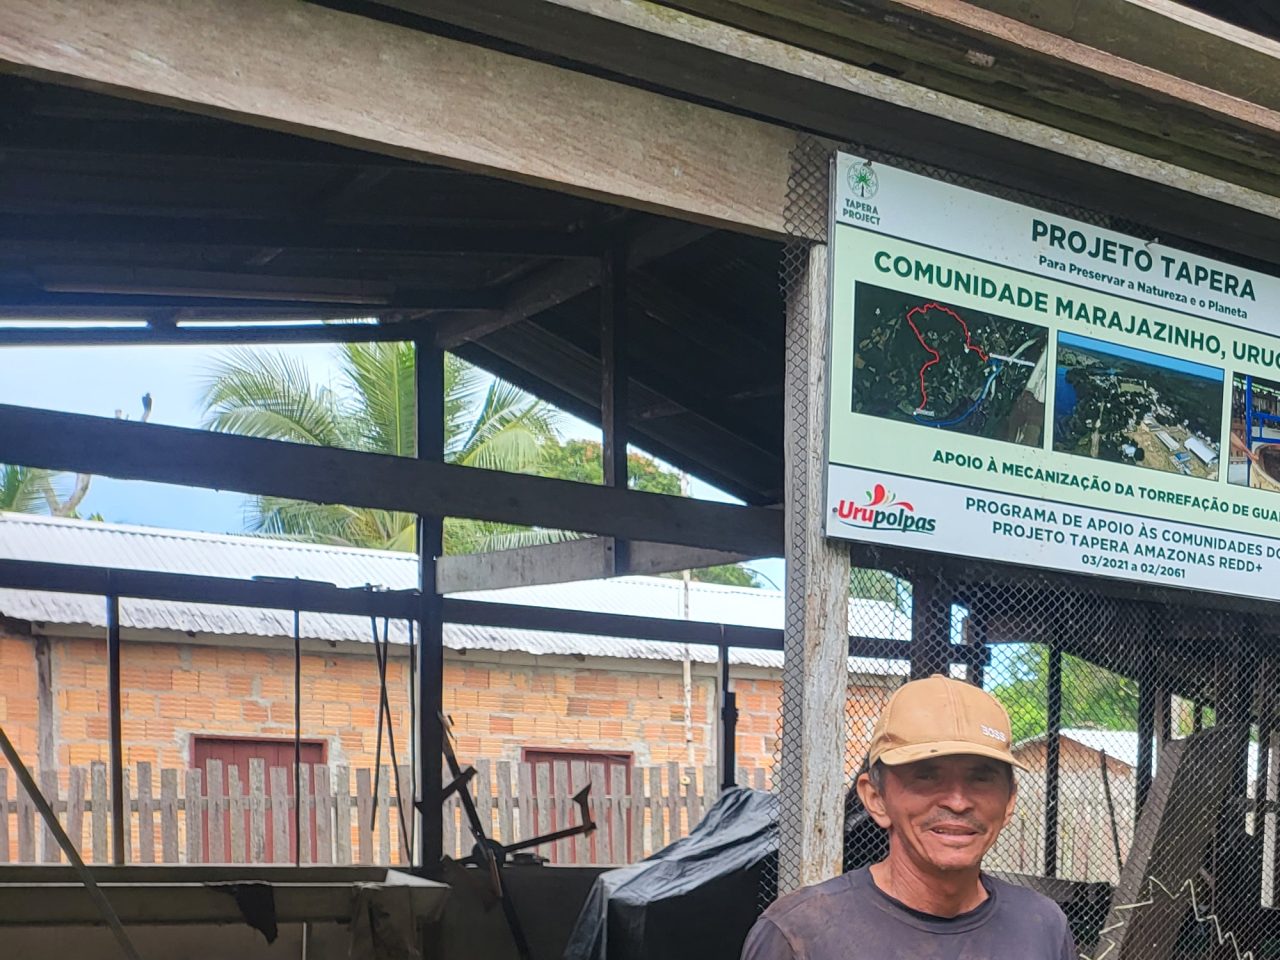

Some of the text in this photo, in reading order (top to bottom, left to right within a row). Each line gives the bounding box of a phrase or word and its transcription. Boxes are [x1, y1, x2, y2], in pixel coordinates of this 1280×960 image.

[843, 208, 881, 225] PROJECT
[845, 199, 878, 215] TAPERA
[1032, 219, 1256, 301] PROJETO TAPERA
[1039, 255, 1248, 319] Para Preservar a Natureza e o Planeta
[874, 250, 1049, 313] COMUNIDADE
[1055, 297, 1226, 359] MARAJAZINHO,
[933, 450, 983, 470] APOIO
[987, 456, 998, 473] À
[1002, 462, 1111, 492] MECANIZAÇÃO
[1114, 483, 1134, 497] DA
[1138, 487, 1229, 513] TORREFAÇÃO
[1232, 504, 1249, 516] DE
[838, 499, 936, 533] Urupolpas
[966, 497, 1057, 524] PROGRAMA
[1062, 513, 1082, 527] DE
[1086, 517, 1134, 536] APOIO
[1138, 523, 1157, 540] ÀS
[1162, 529, 1262, 556] COMUNIDADES
[993, 521, 1263, 572] PROJETO TAPERA AMAZONAS REDD+
[1082, 555, 1128, 571] 03/2021
[1140, 564, 1186, 578] 02/2061
